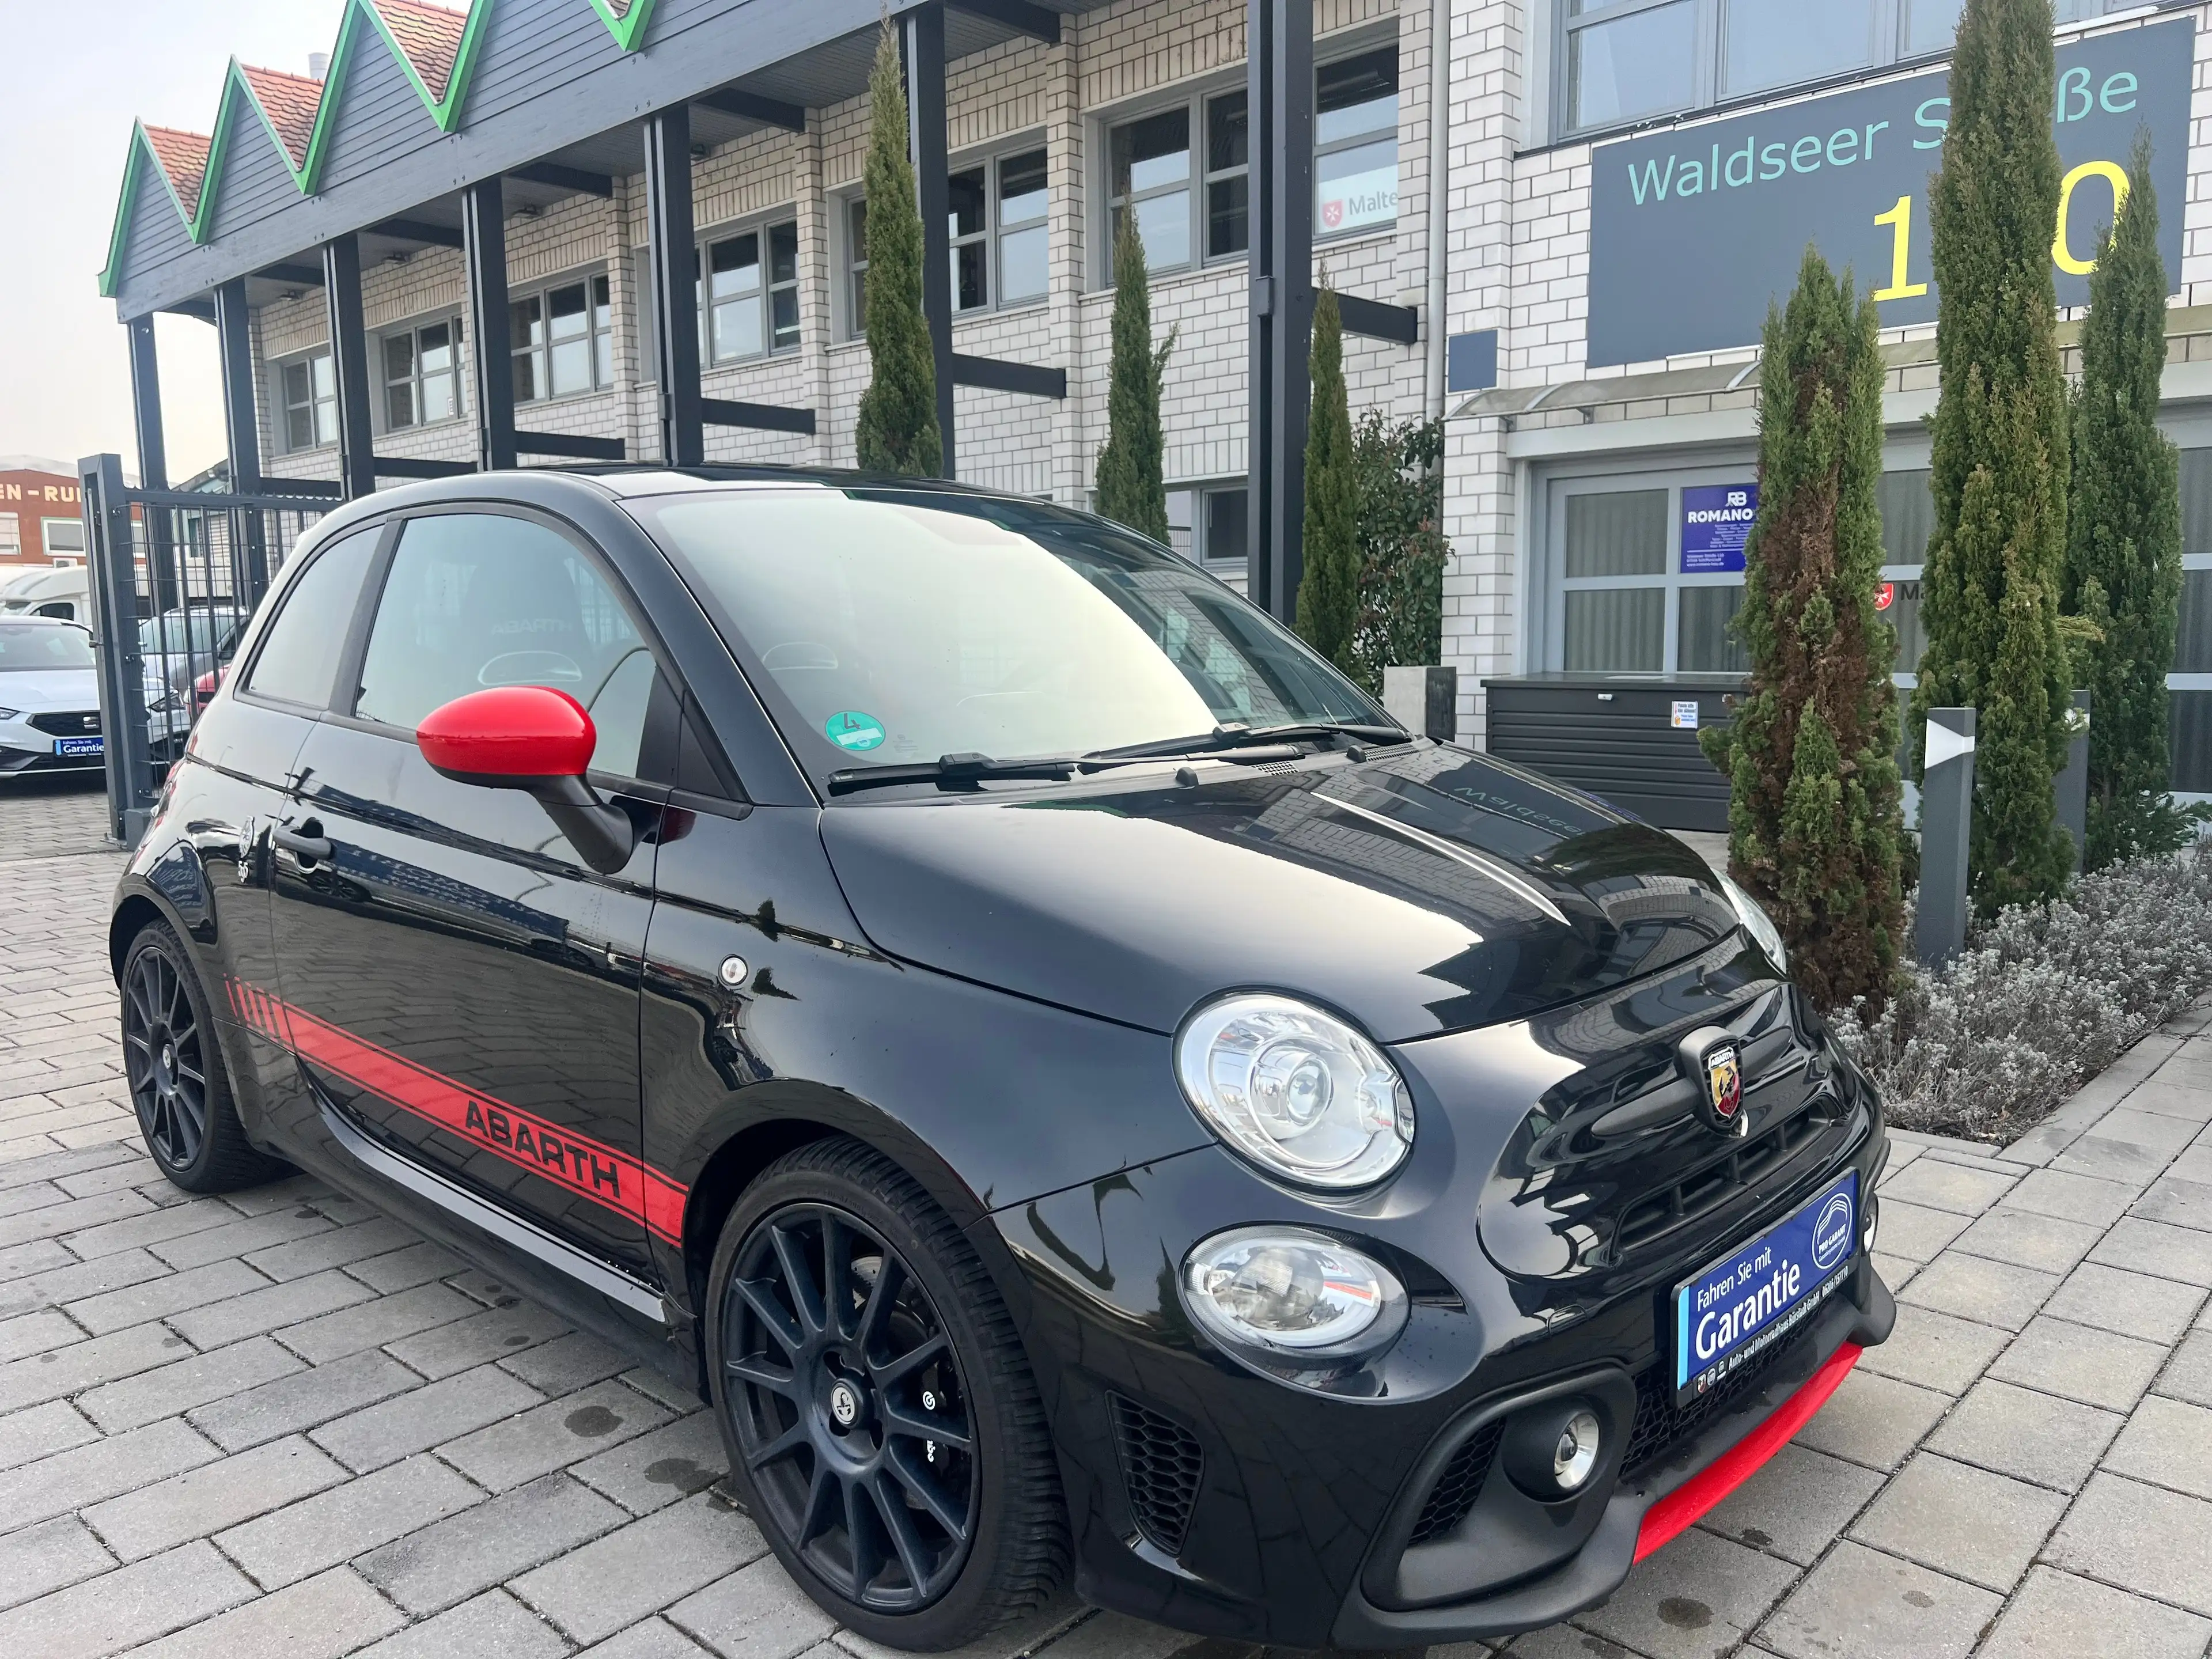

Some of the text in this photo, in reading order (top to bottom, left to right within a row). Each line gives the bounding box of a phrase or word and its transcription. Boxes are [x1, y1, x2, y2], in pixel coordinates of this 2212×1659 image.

[1628, 67, 2138, 206] Waldseer Sße
[1873, 160, 2130, 302] 10
[1687, 508, 1753, 523] ROMANO
[491, 618, 575, 636] ABARTH
[843, 713, 861, 730] 4
[63, 743, 104, 753] Garantie
[1710, 1052, 1735, 1067] ABARTH
[465, 1100, 620, 1199] ABARTH
[1697, 1247, 1771, 1312] Fahren Sie mit
[1695, 1259, 1800, 1359] Garantie
[1744, 1340, 1755, 1359] und
[1755, 1319, 1789, 1351] Motorradhaus
